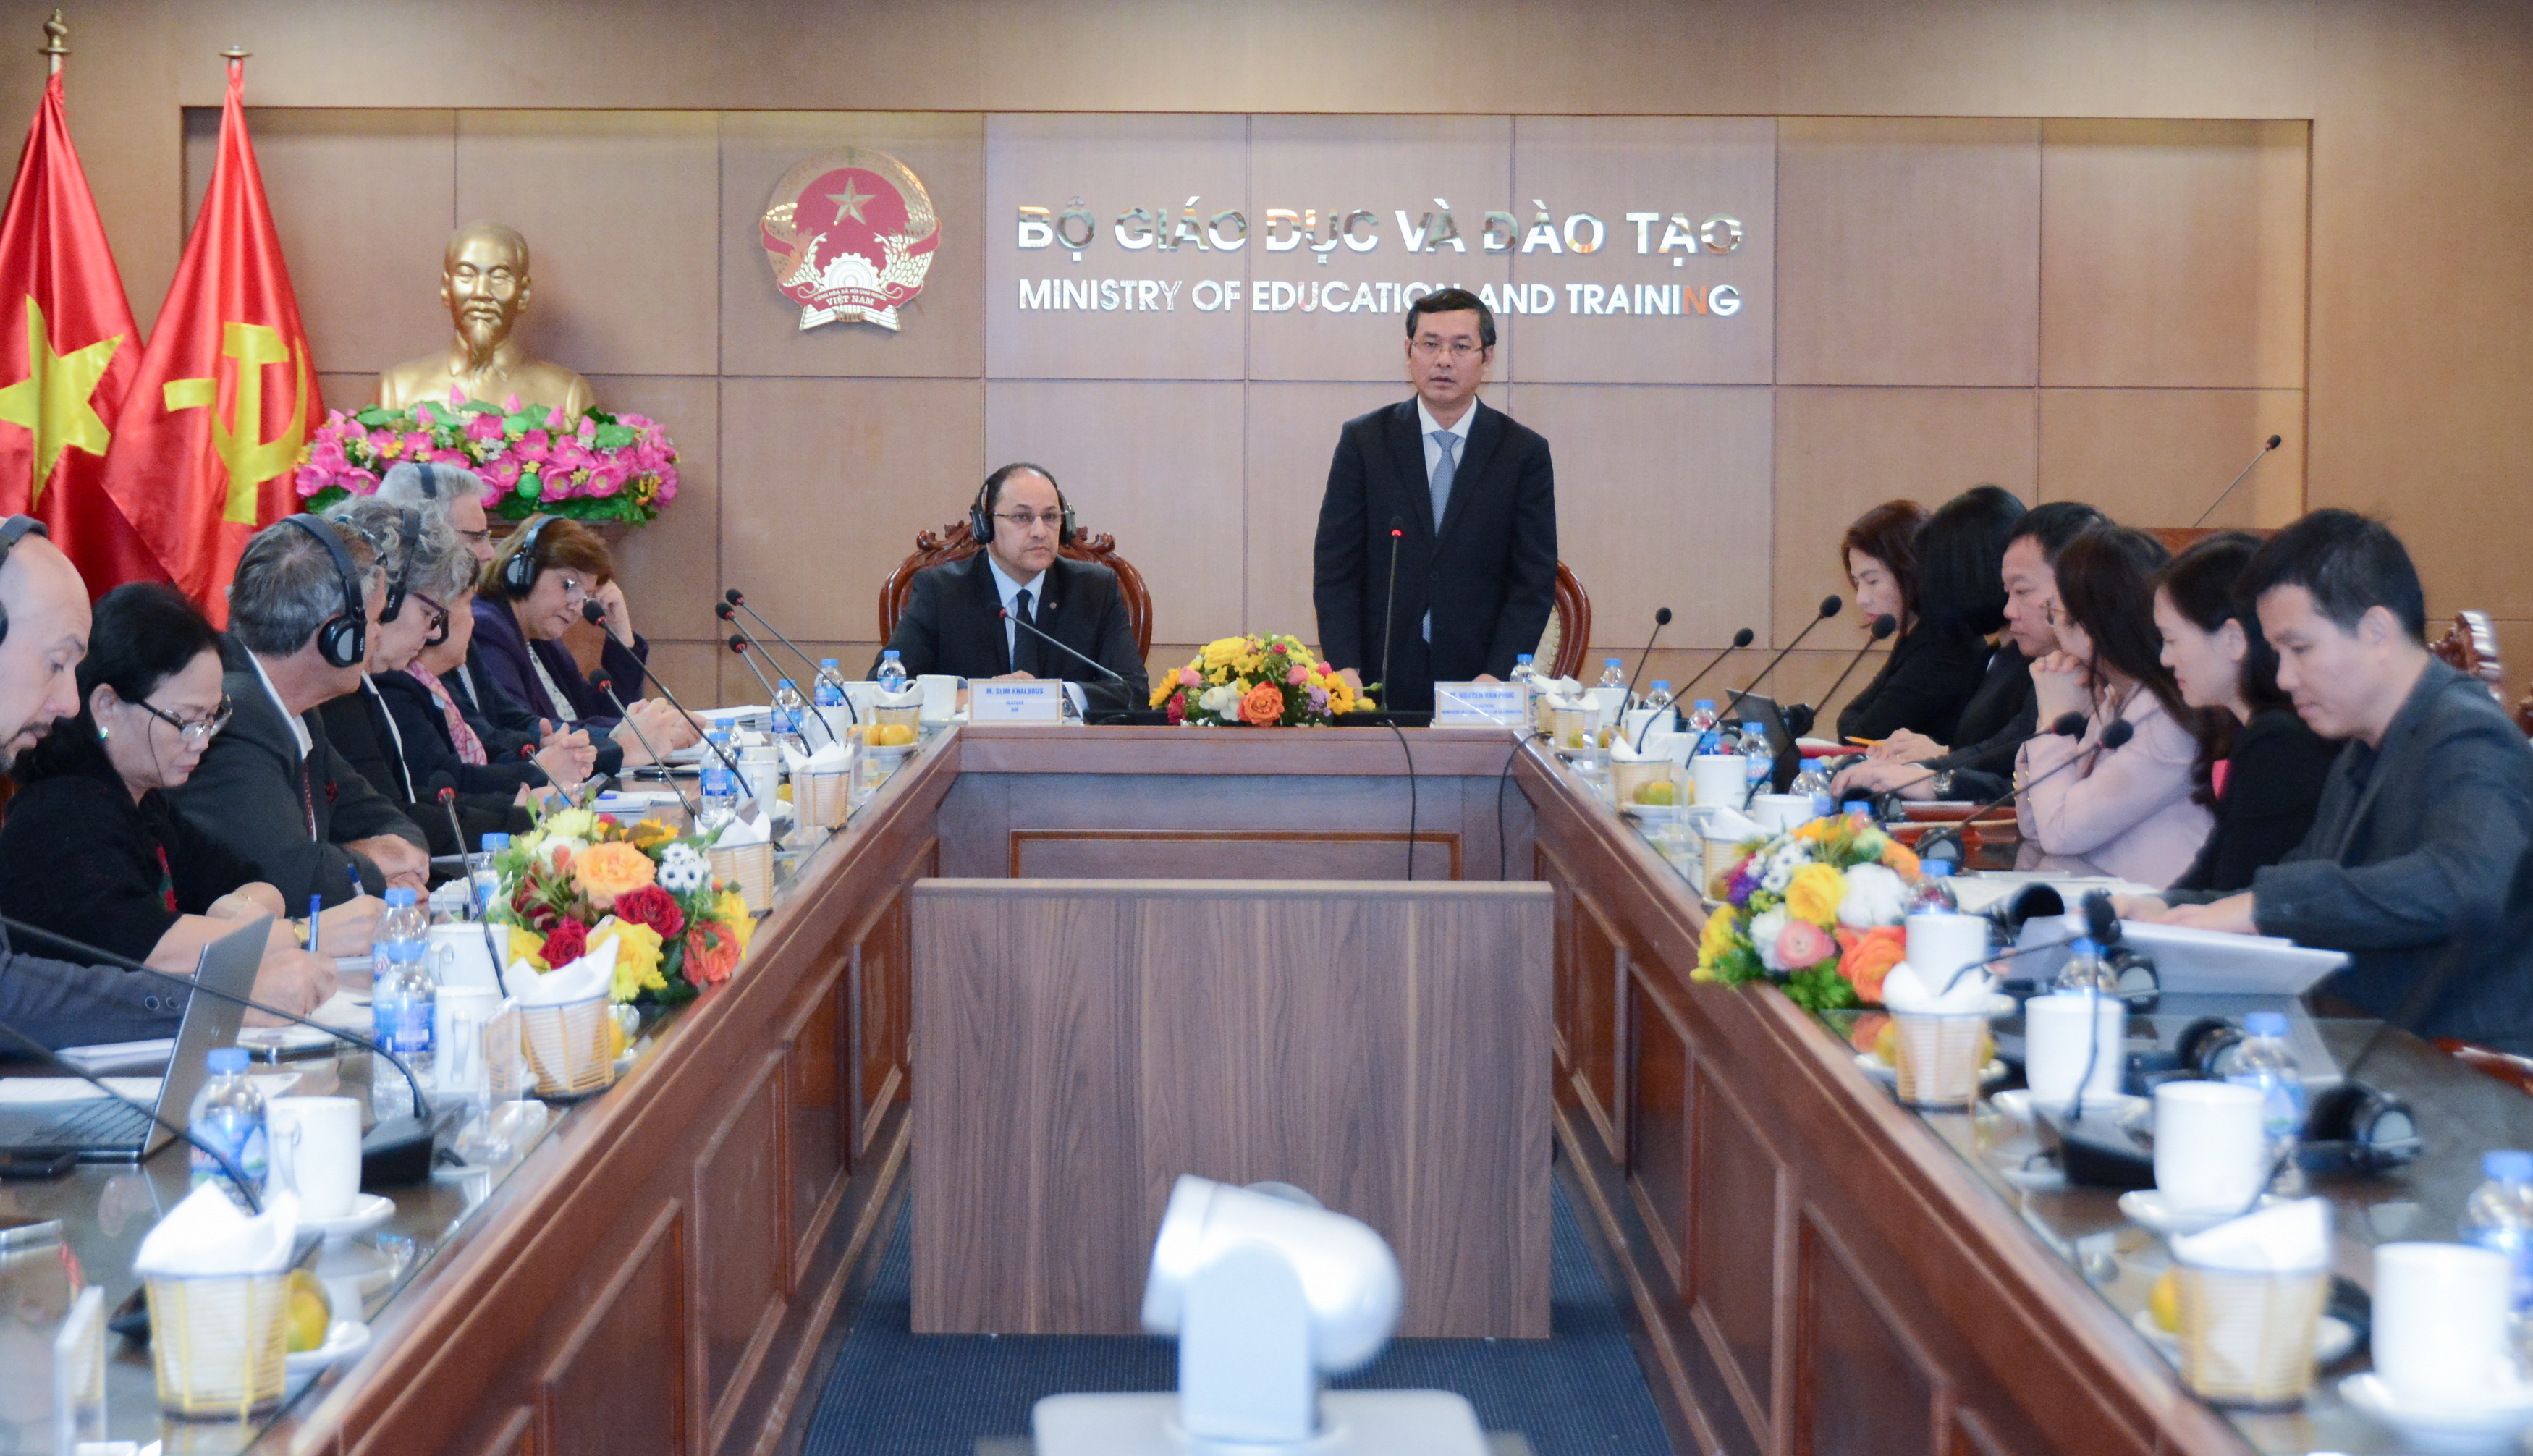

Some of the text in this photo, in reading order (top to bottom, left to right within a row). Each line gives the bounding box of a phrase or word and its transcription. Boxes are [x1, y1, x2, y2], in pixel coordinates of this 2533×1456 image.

[1018, 195, 1743, 267] BỘ GIÁO DỤC VÀ ĐÀO TẠO
[826, 294, 875, 306] VIỆT NAM
[1018, 279, 1740, 316] MINISTRY OF EDUCATIO AND TRAINING
